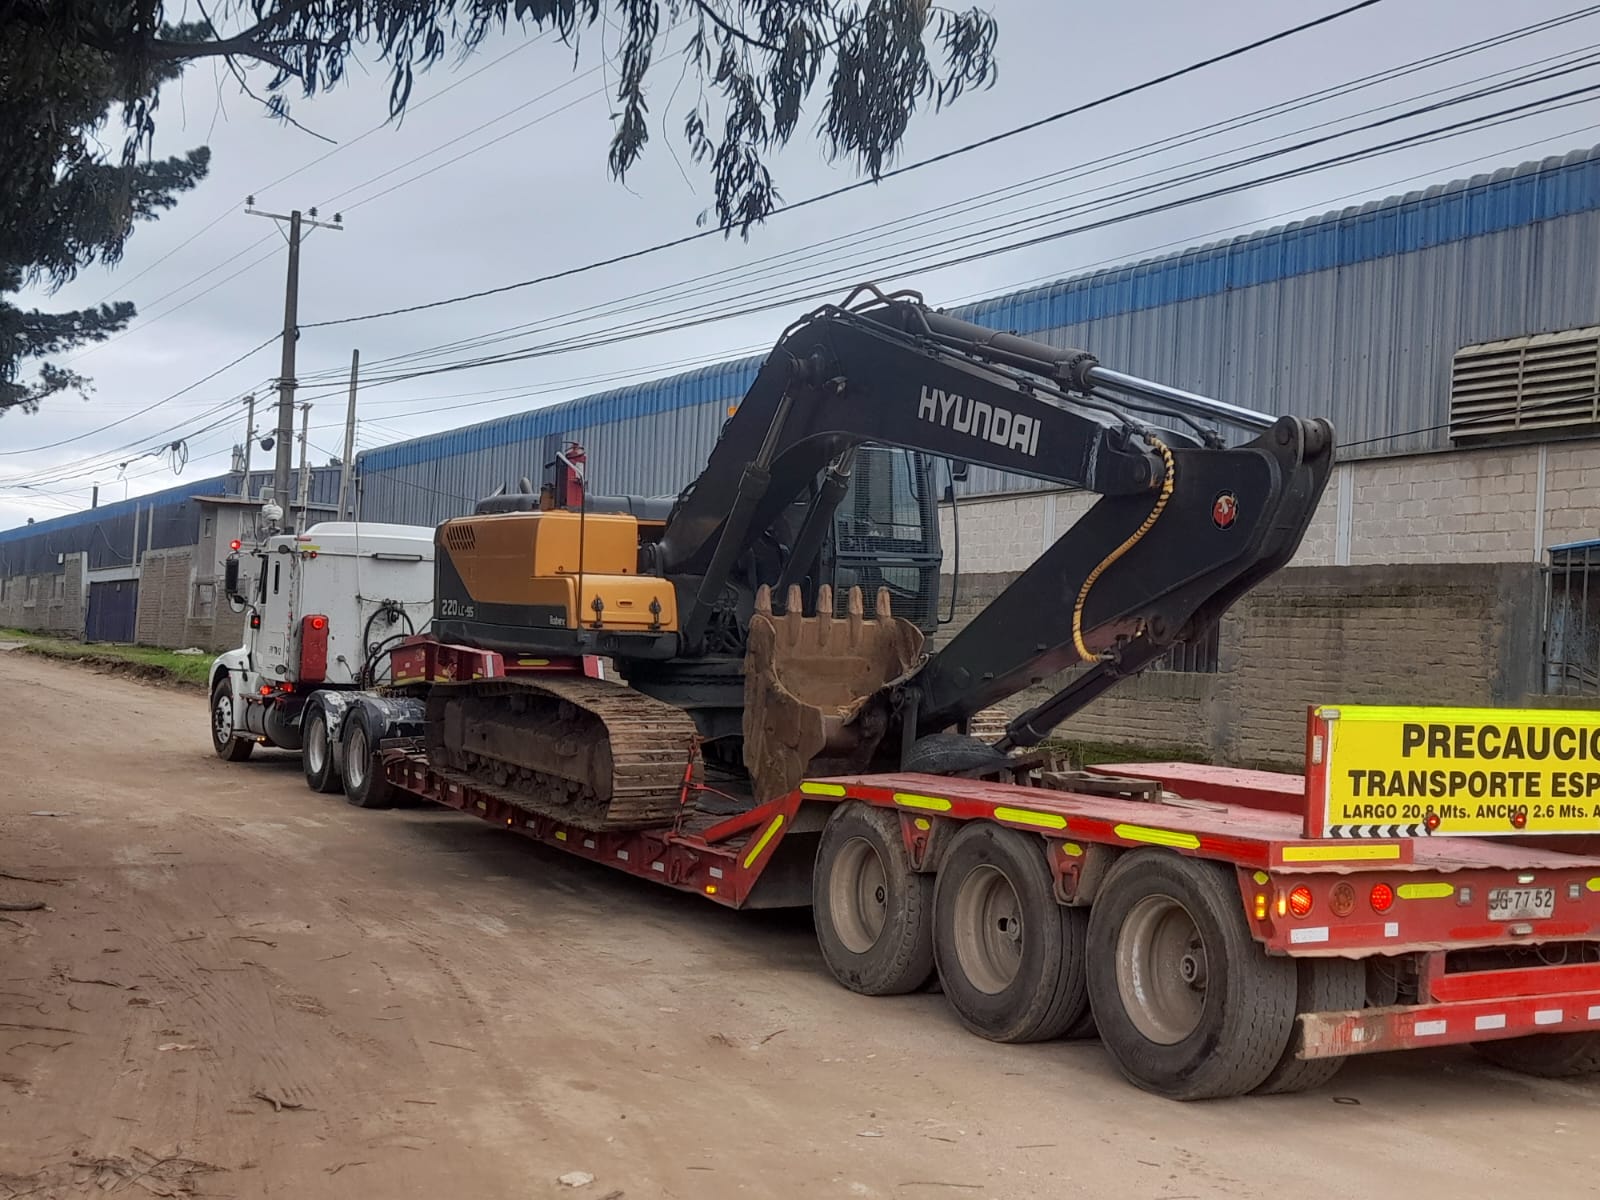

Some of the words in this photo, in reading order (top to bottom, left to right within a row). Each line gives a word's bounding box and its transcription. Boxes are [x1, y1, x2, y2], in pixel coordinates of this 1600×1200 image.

[918, 384, 1042, 457] HYUNDAI
[442, 599, 458, 616] 220
[1348, 769, 1541, 798] TRANSPORTE
[1343, 804, 1397, 819] LARGO
[1440, 804, 1471, 819] Mts.
[1476, 804, 1528, 818] ANCHO
[1533, 804, 1555, 818] 2.6
[1559, 804, 1588, 818] Mts.
